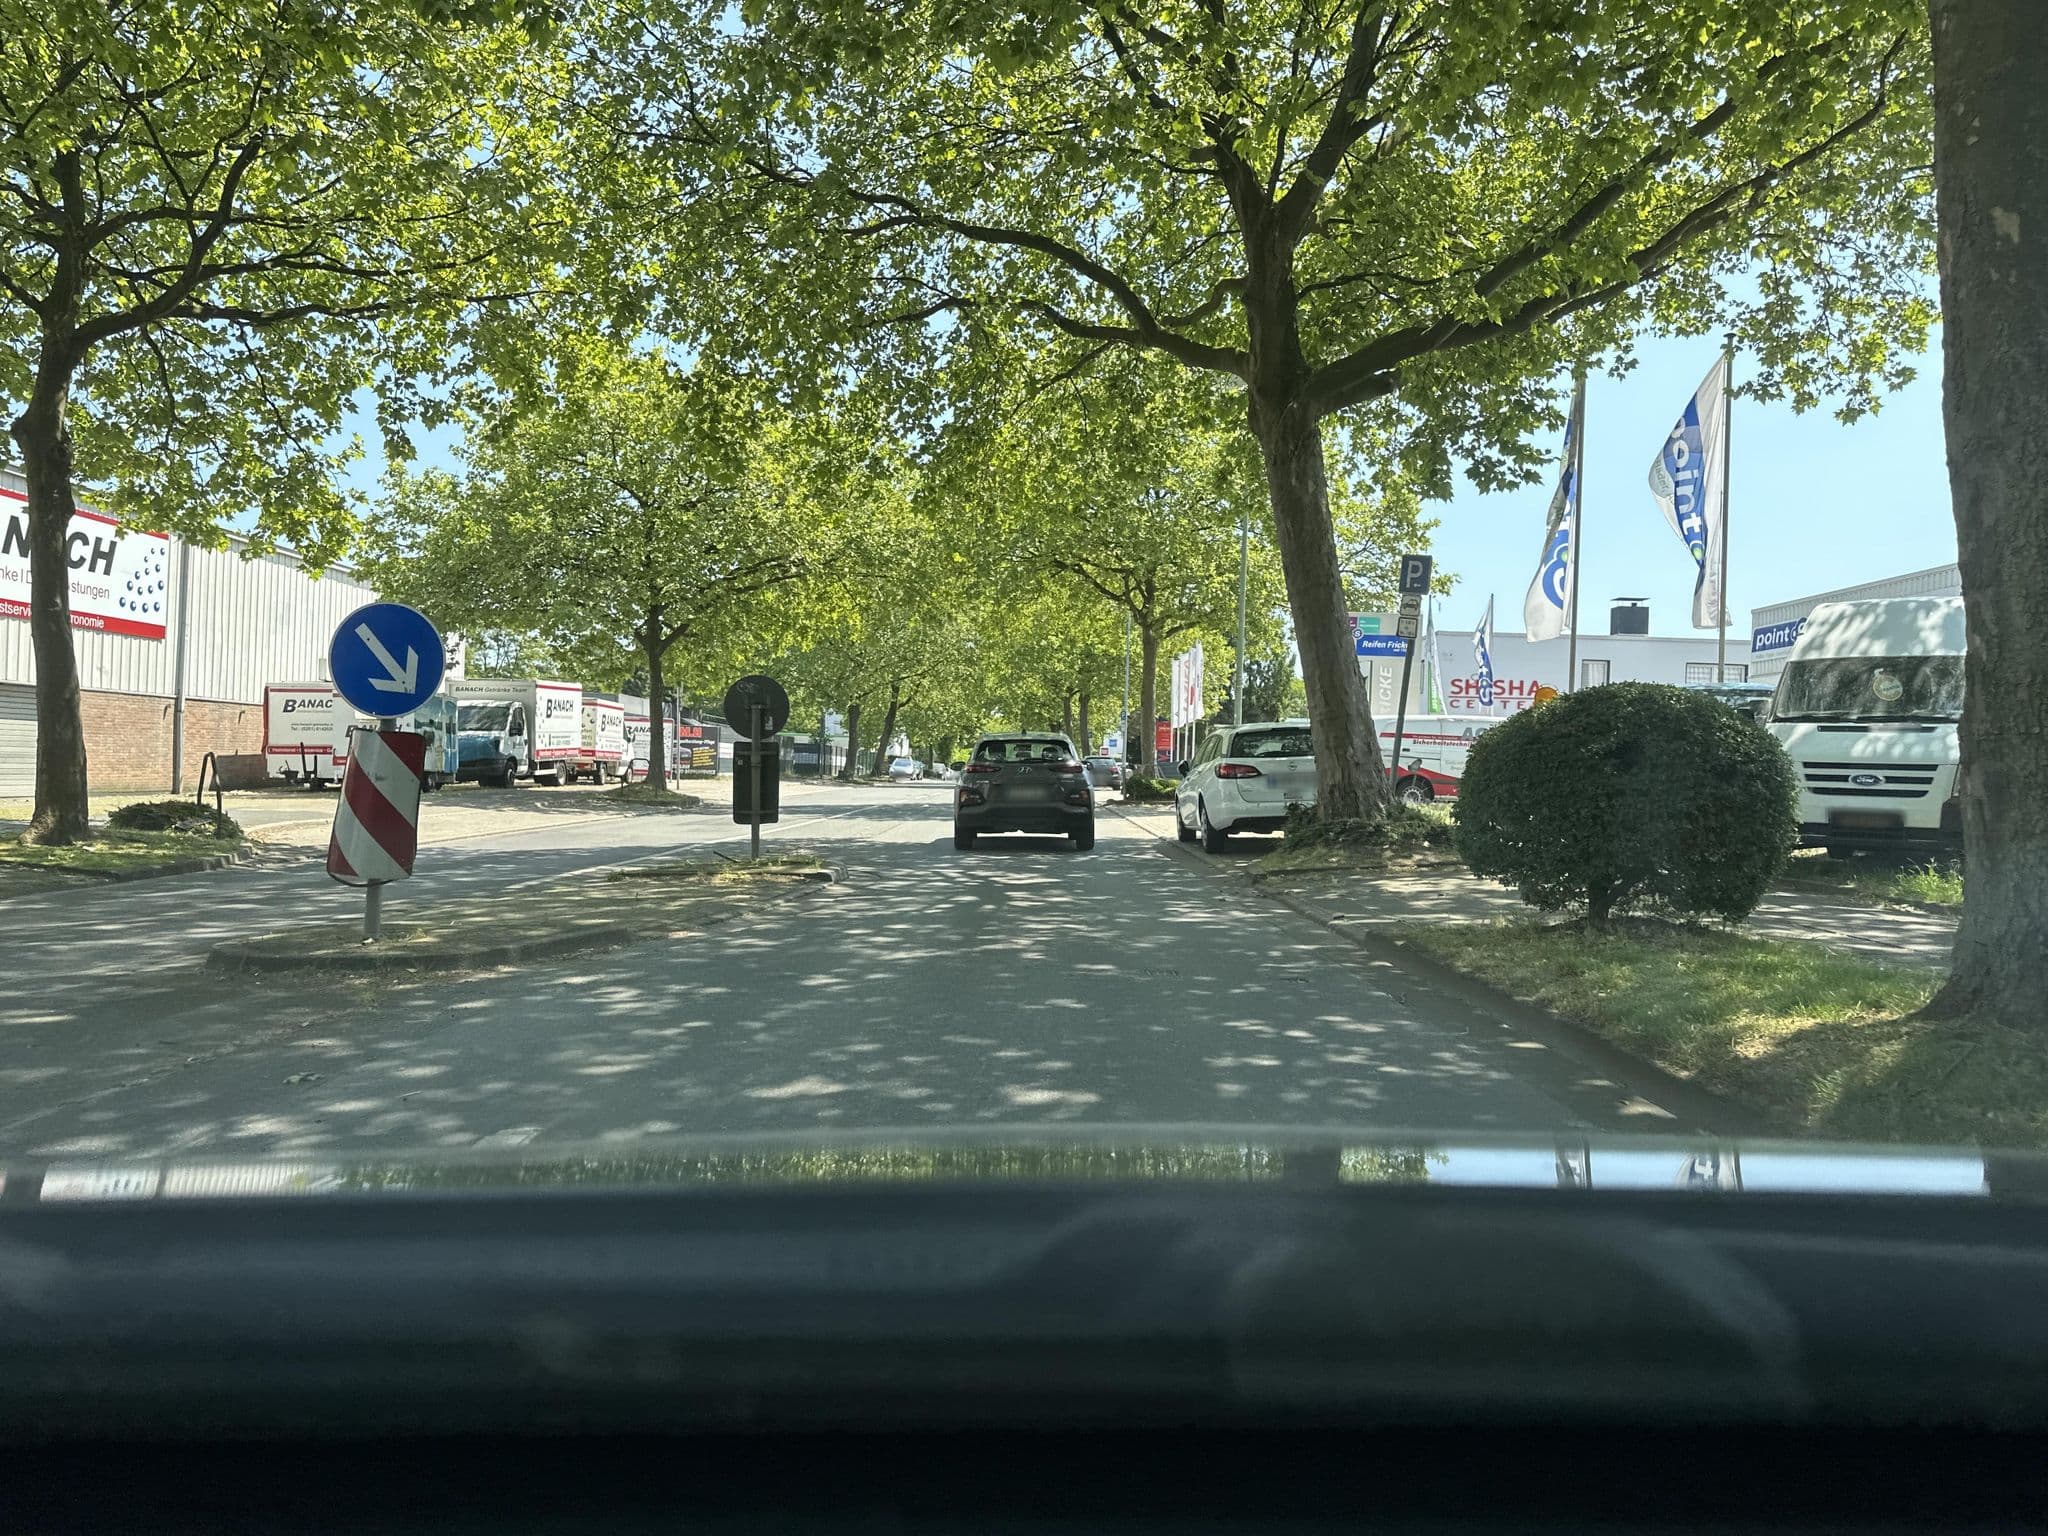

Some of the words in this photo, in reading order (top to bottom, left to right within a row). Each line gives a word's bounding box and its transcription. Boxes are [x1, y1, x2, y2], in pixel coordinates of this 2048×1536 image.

[1, 514, 118, 577] NCH
[1405, 560, 1424, 589] P
[70, 580, 110, 600] stungen
[0, 601, 32, 617] stservi
[70, 614, 105, 629] ronomie
[1362, 640, 1386, 649] Reifen
[1379, 666, 1393, 712] ICKE
[1450, 678, 1541, 697] SHSHA
[282, 698, 334, 713] BANAC
[545, 698, 574, 719] BANACH
[1449, 699, 1526, 710] CETE
